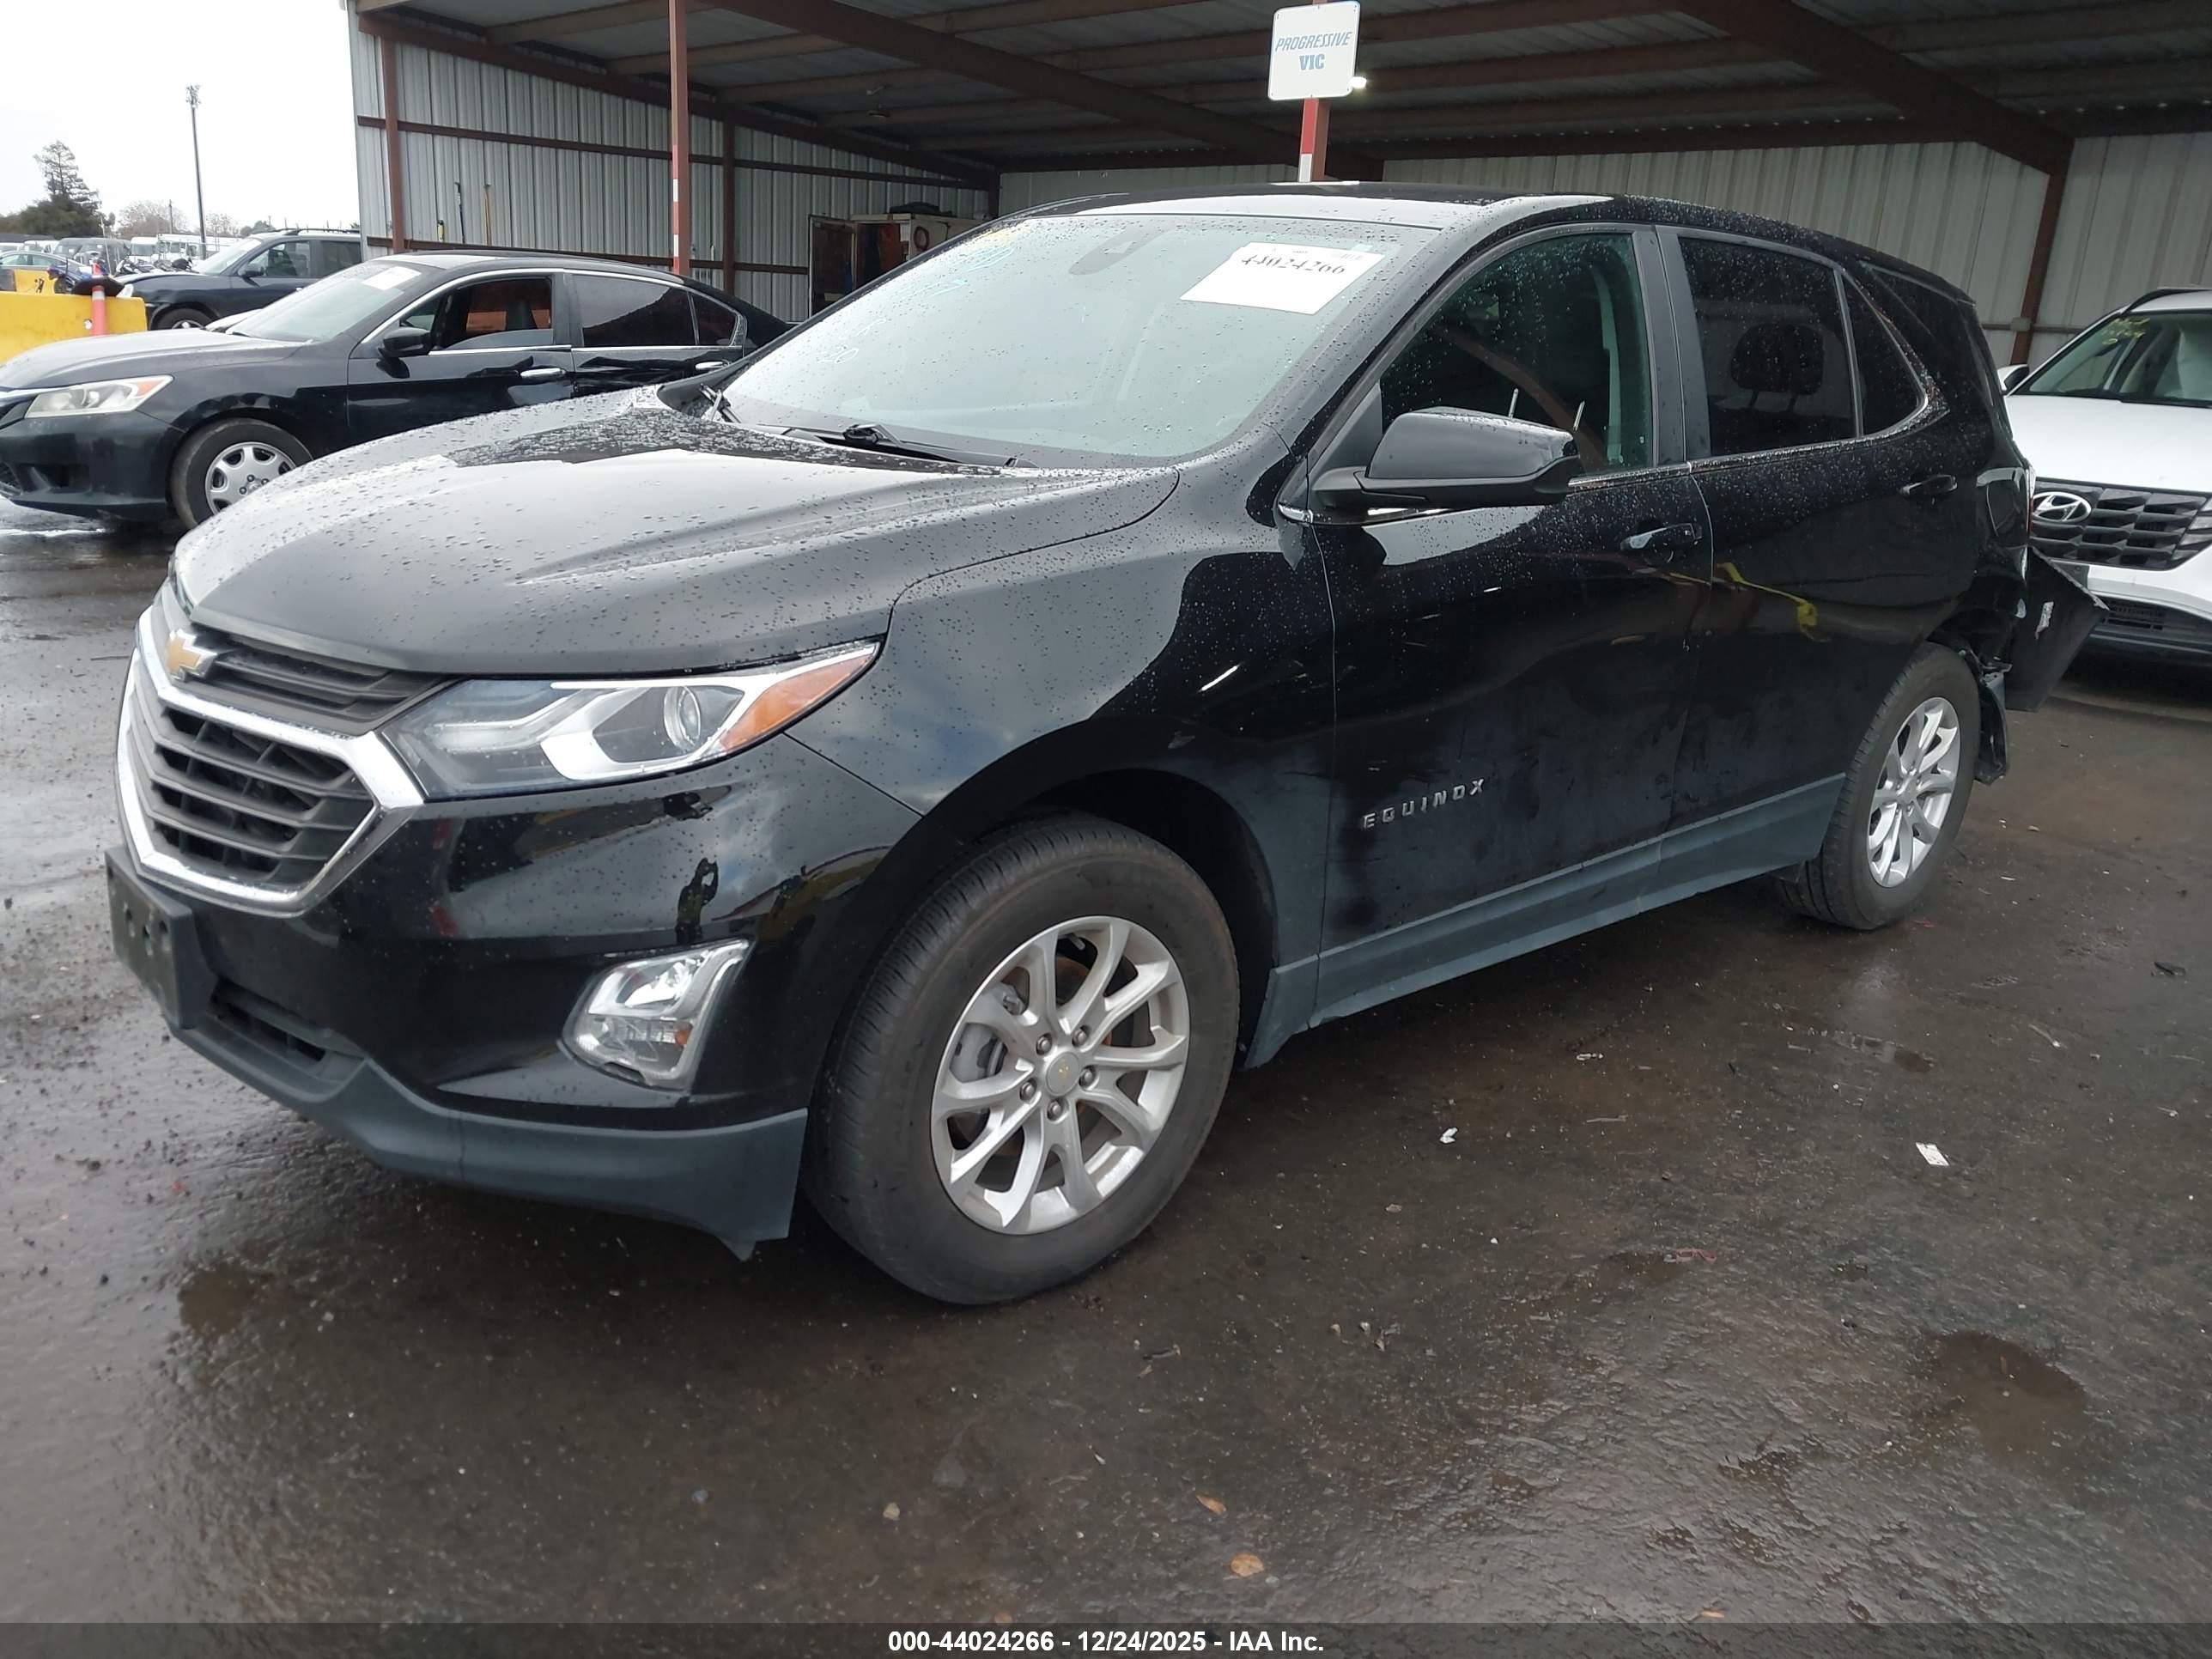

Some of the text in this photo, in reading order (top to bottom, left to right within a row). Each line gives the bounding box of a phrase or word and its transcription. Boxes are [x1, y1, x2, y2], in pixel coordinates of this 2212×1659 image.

[1275, 32, 1352, 52] PROGRESSIVE
[1299, 54, 1325, 70] VIC
[1363, 778, 1484, 829] EQUINOX
